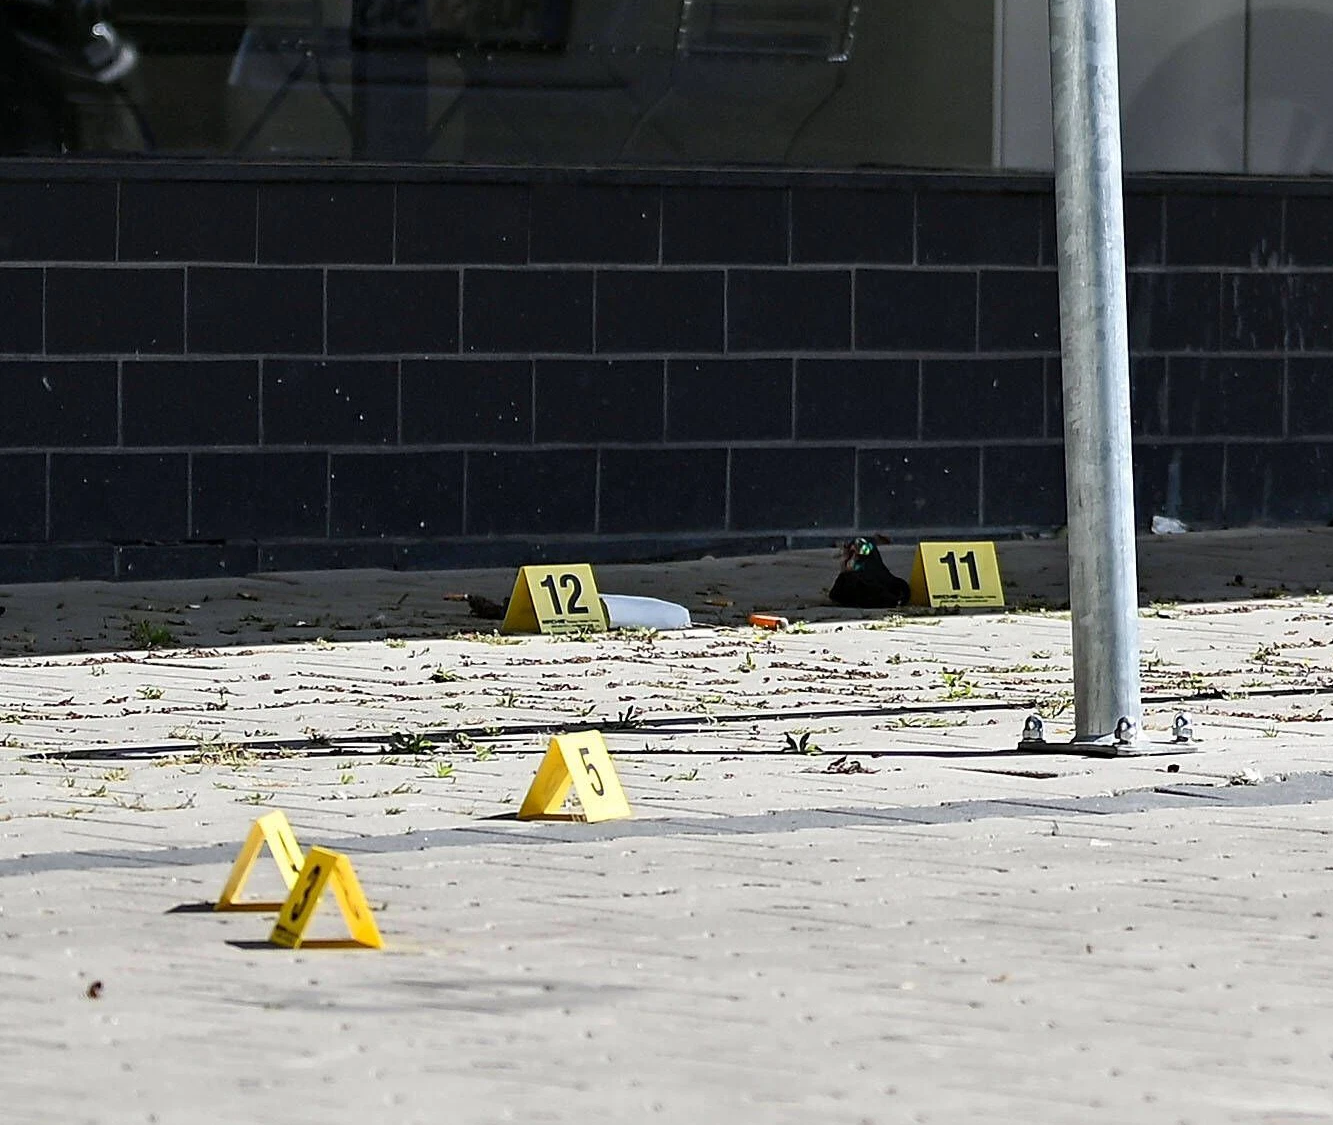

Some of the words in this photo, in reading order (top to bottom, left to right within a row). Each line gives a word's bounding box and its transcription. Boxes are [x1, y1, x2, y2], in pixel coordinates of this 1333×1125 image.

[940, 551, 980, 590] 11
[541, 574, 589, 614] 12
[579, 748, 604, 796] 5
